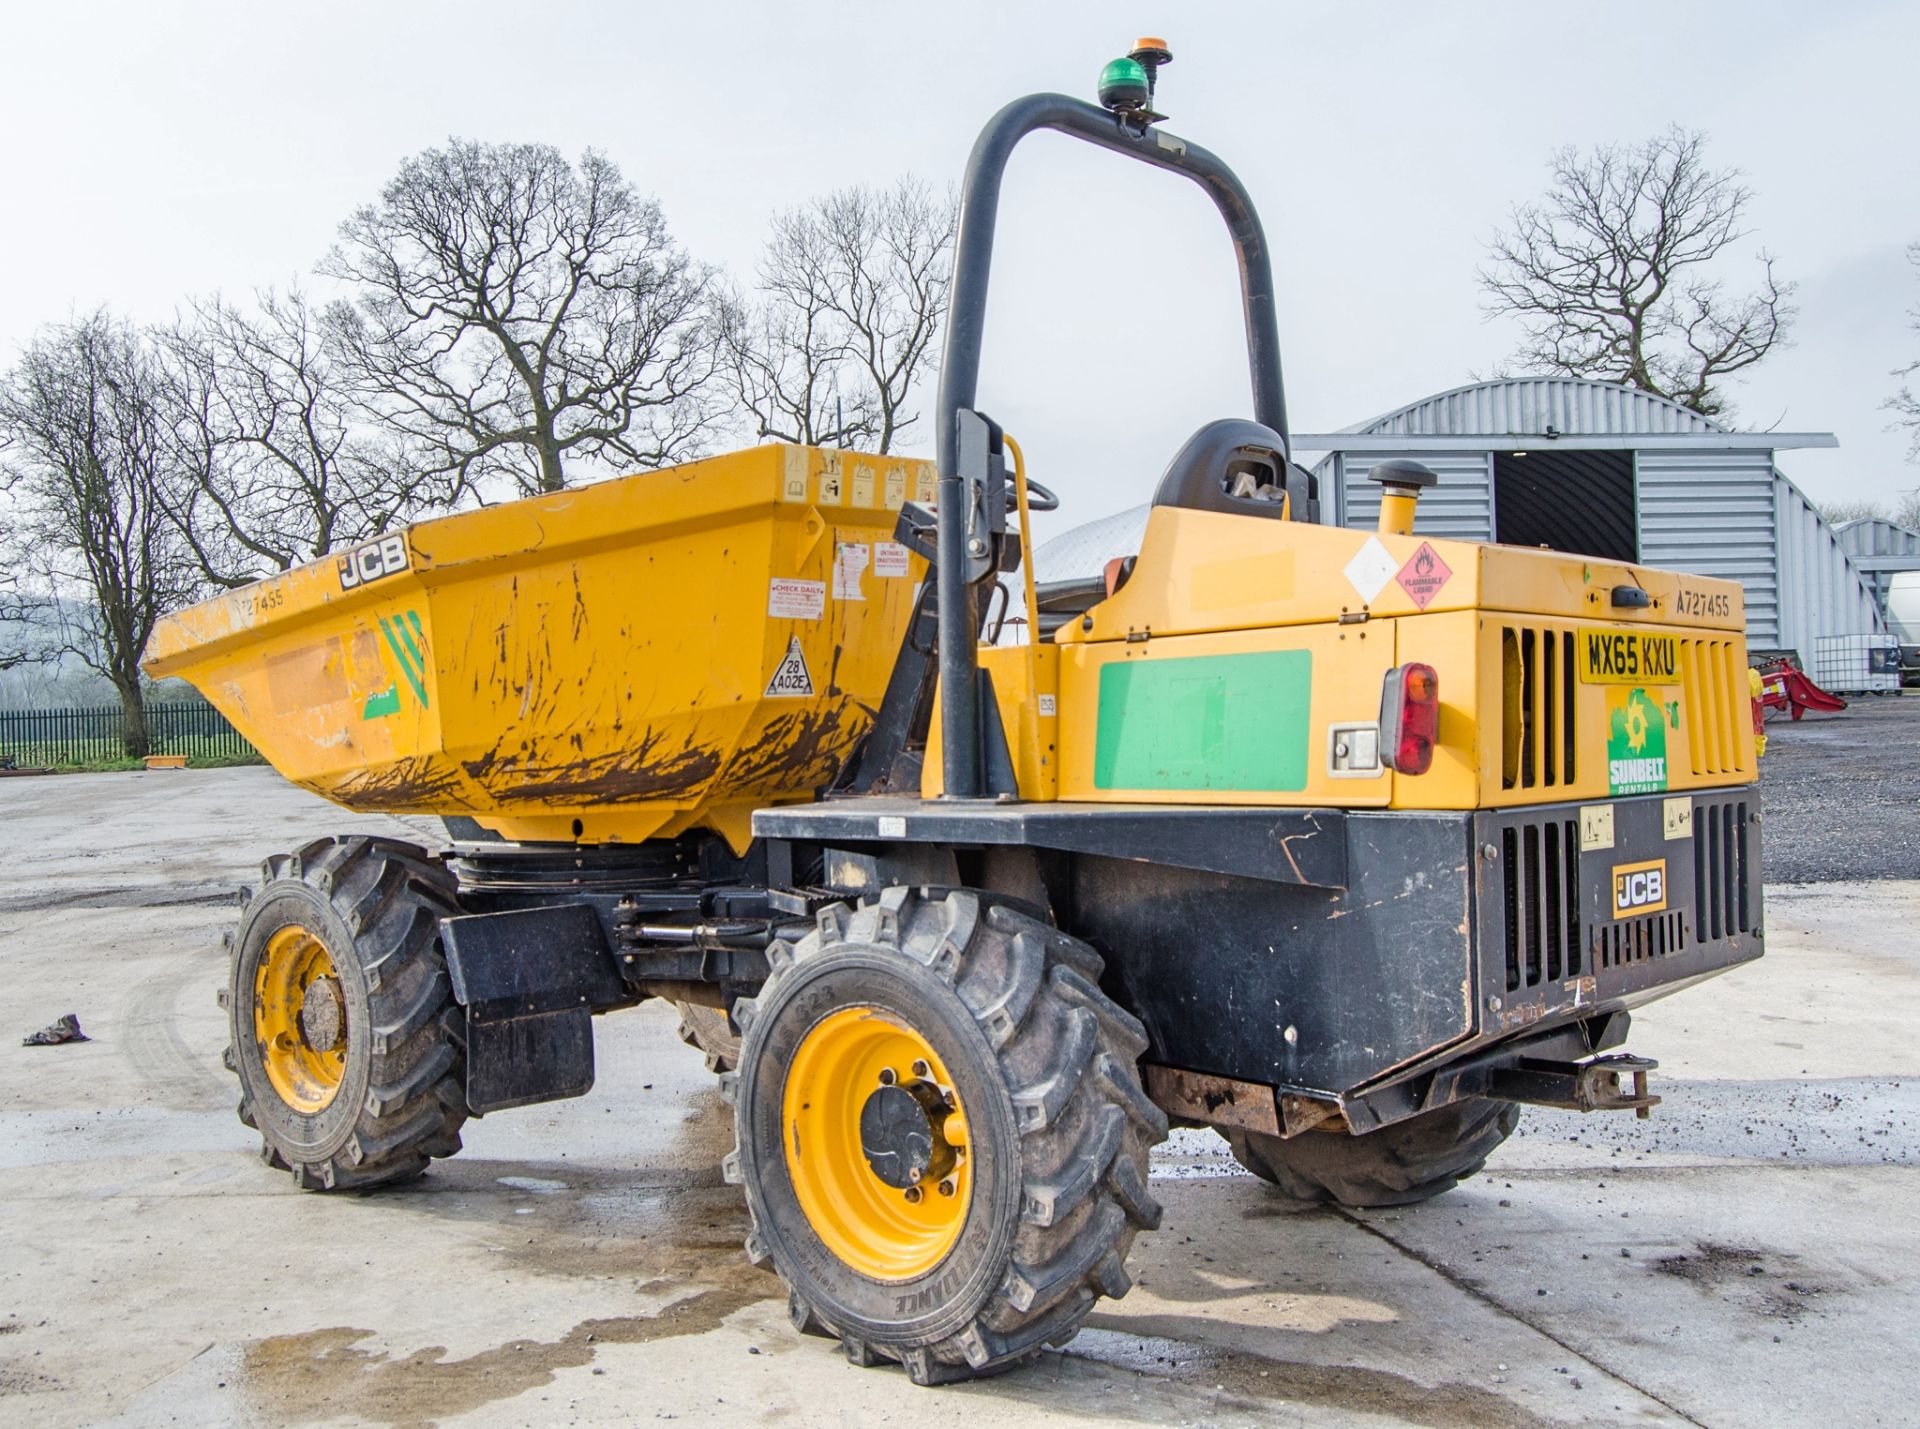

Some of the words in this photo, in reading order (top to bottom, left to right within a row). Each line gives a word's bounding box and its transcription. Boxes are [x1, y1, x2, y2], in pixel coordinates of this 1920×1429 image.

[340, 535, 407, 588] JCB
[1676, 590, 1730, 617] A727455
[786, 660, 800, 674] 28
[1589, 634, 1638, 675] MX65
[1643, 637, 1675, 676] KXU
[777, 675, 805, 689] A02E
[1609, 758, 1664, 785] SUNBELT
[1617, 782, 1658, 796] RENTALS
[1617, 870, 1662, 907] JCB
